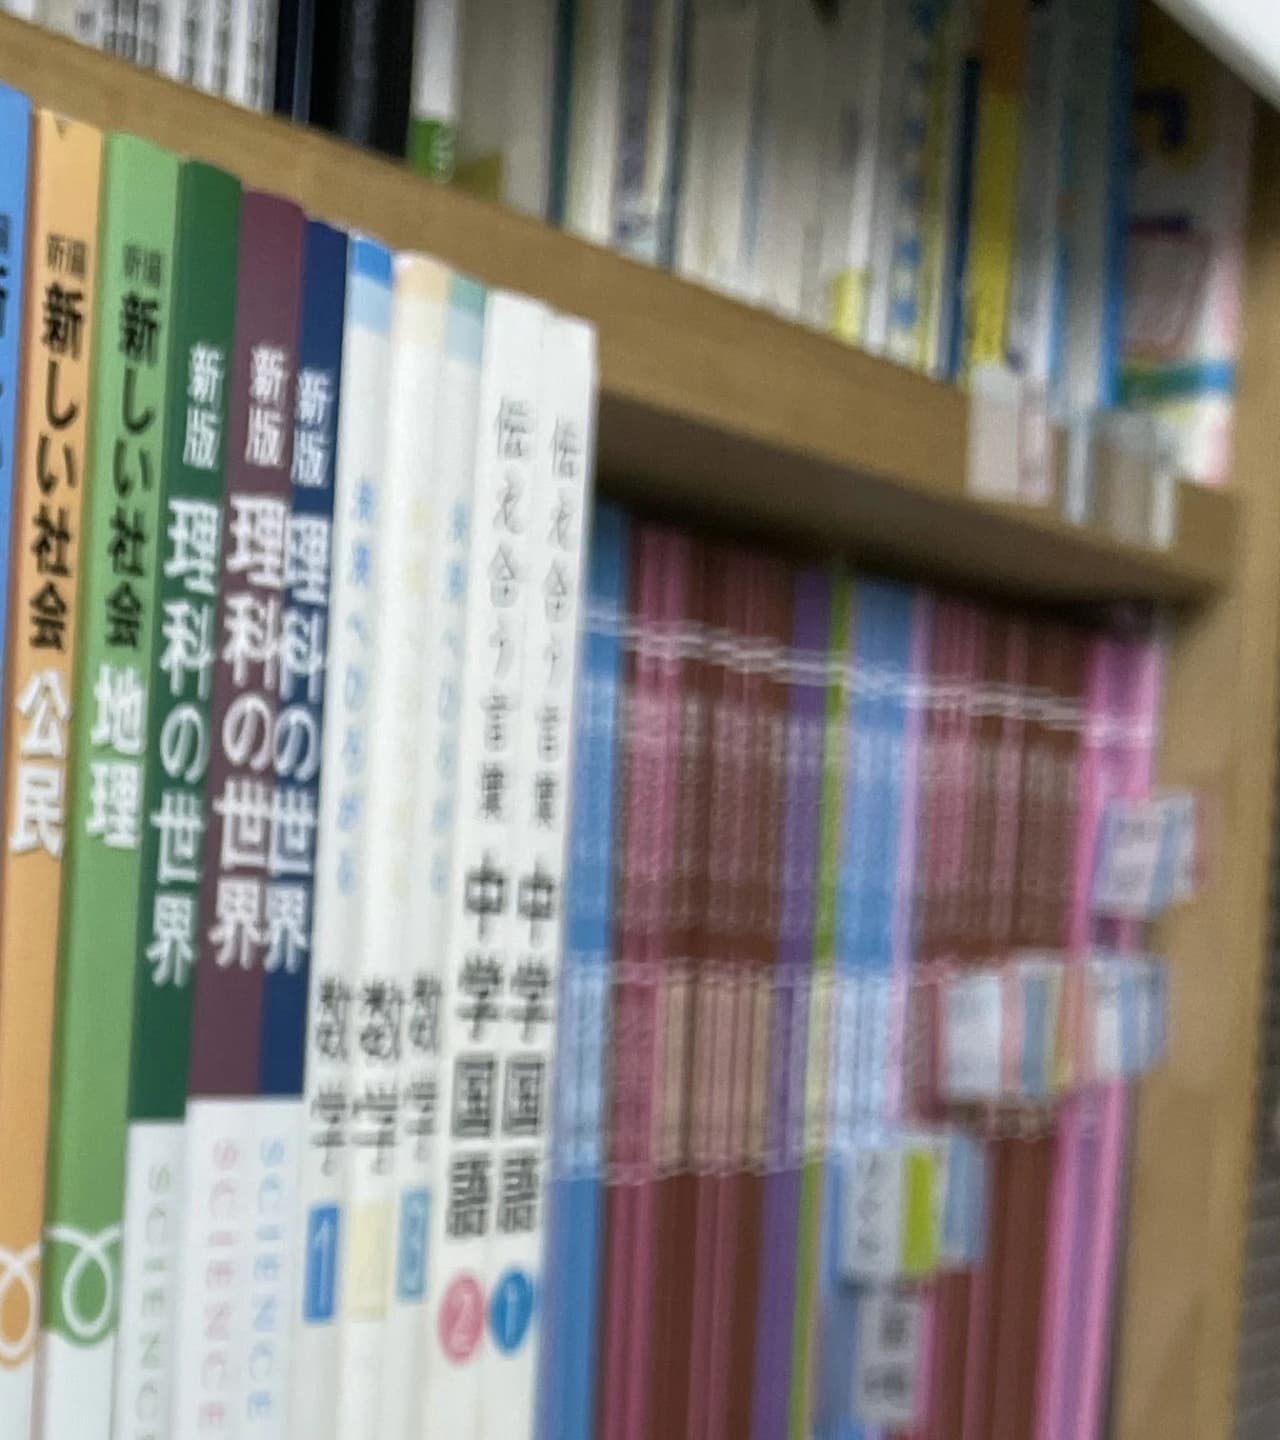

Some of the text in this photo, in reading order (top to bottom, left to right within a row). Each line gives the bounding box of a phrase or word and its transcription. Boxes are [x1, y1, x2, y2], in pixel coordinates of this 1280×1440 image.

[30, 282, 86, 654] 新しい社会
[105, 289, 161, 650] 新しい社会
[183, 342, 226, 471] 新版
[245, 342, 288, 467] 新版
[9, 669, 71, 858] 公民
[86, 662, 146, 850] 地理
[146, 499, 220, 987] 理科の世界
[209, 493, 288, 970] 理科の世界
[263, 515, 331, 973] 理科の世界
[447, 855, 505, 1240] 中学国語
[497, 856, 557, 1235] 中学国語
